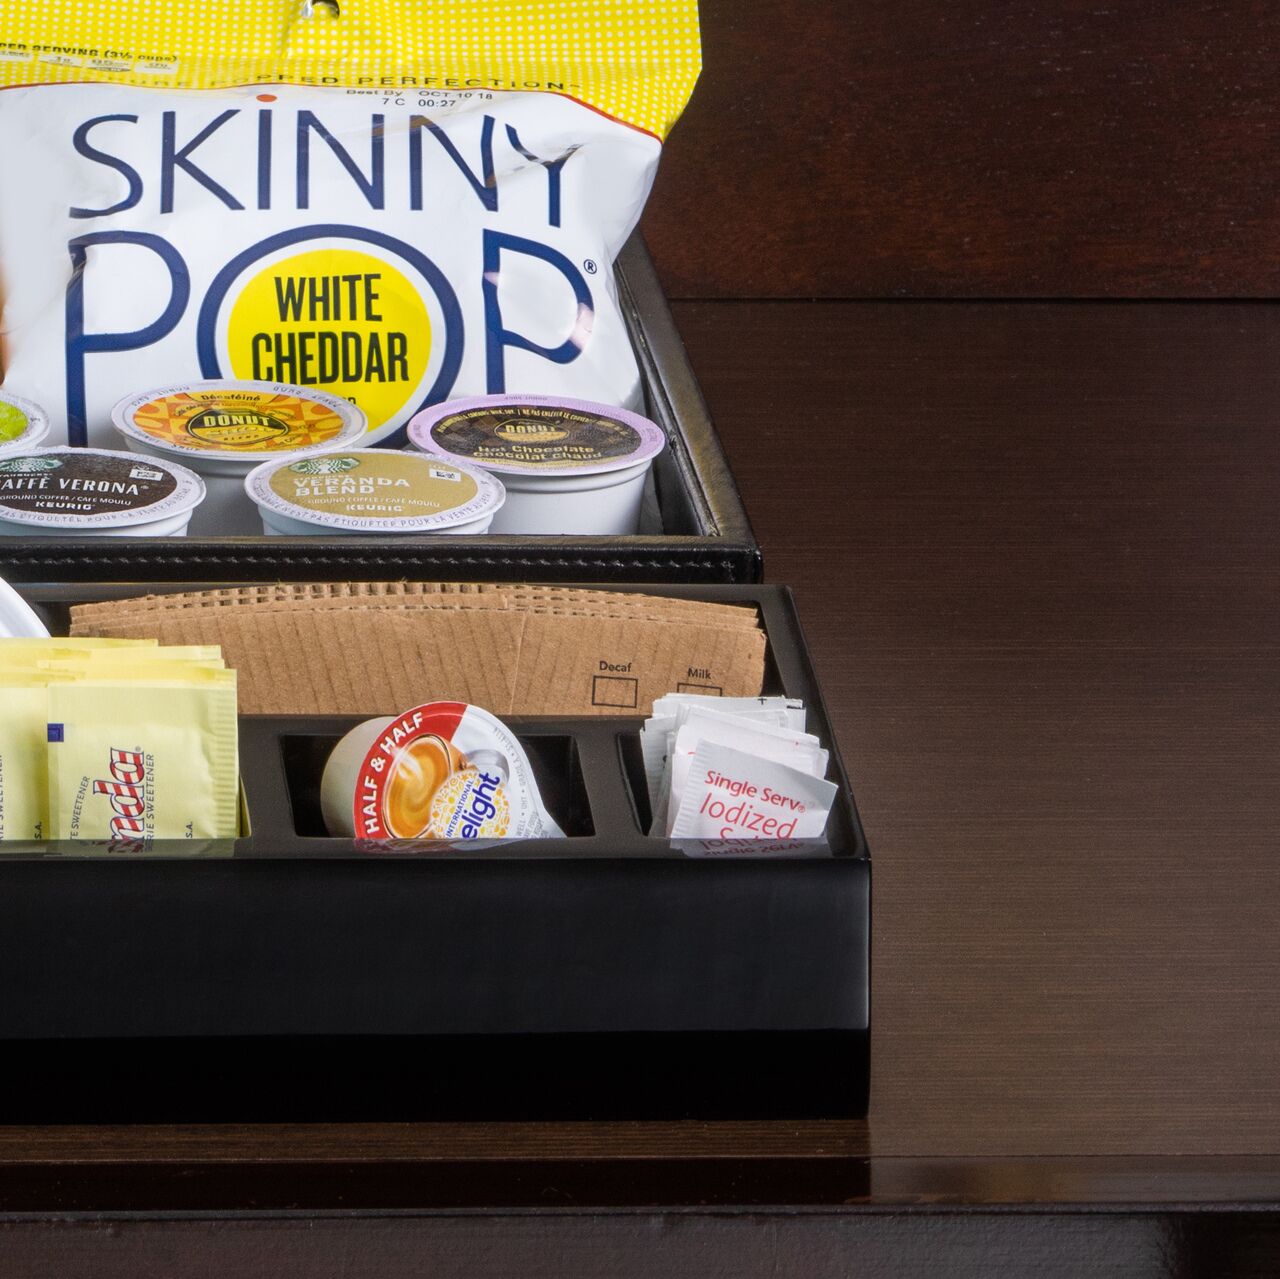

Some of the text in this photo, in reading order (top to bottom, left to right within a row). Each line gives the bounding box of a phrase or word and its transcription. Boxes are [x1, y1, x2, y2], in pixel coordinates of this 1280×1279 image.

[32, 45, 99, 57] SERVING
[211, 74, 338, 87] POPPED
[358, 76, 565, 90] PERFECTION
[345, 88, 494, 101] Best By OCT 10 18
[382, 98, 456, 108] 7 C 00:27
[274, 272, 382, 322] WHITE
[65, 223, 596, 448] POP
[251, 331, 410, 386] CHEDDAR
[202, 414, 270, 427] DONUT
[505, 424, 556, 433] DONUT
[511, 445, 595, 453] Chocolate
[58, 478, 140, 496] VERONA
[293, 476, 411, 488] VERANDA
[295, 486, 375, 497] BLEND
[35, 501, 93, 510] KEURIG
[100, 498, 132, 506] MOULU
[346, 504, 404, 512] KEURIG
[408, 500, 440, 508] MOULU
[598, 660, 633, 673] Decaf
[687, 667, 712, 680] Milk
[361, 711, 424, 834] HALF & HALF
[146, 753, 155, 821] SWEETENER
[704, 770, 801, 811] Single Serv
[71, 775, 90, 831] SWEETENER
[445, 778, 475, 838] INTERNATIONAL
[700, 792, 799, 841] Iodized
